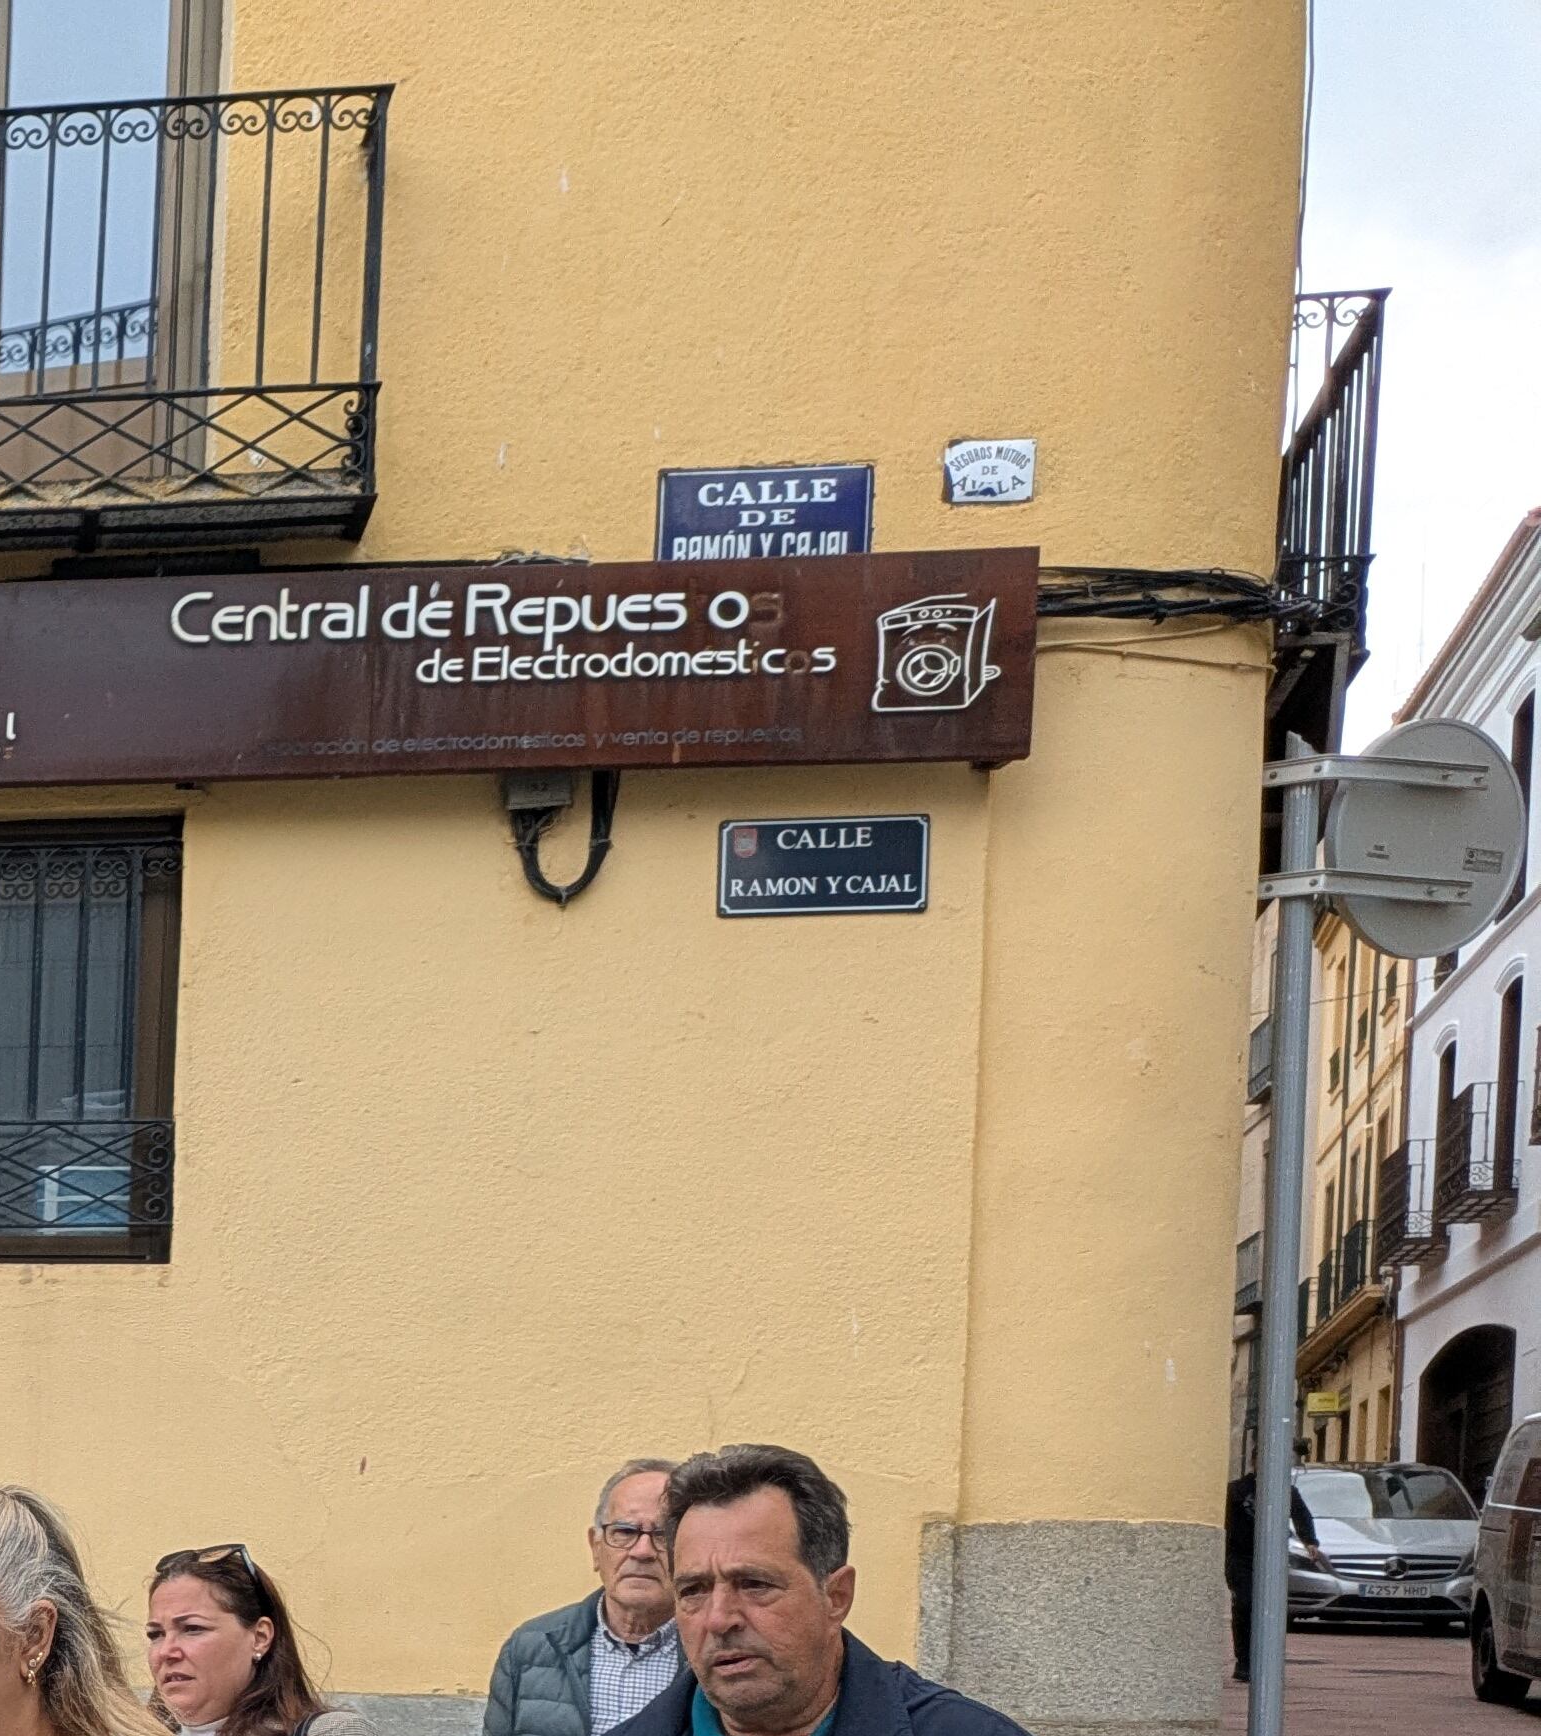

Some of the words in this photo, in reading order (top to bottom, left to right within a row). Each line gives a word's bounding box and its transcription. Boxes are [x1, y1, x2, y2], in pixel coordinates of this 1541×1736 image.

[949, 446, 993, 472] SEGUROS
[995, 446, 1031, 470] MUTUOS
[981, 465, 999, 475] DE
[697, 477, 837, 507] CALLE
[738, 508, 797, 527] DE
[672, 529, 752, 561] RAMÓN
[759, 532, 776, 557] Y
[170, 584, 370, 644] Central
[416, 648, 465, 683] de
[611, 729, 668, 747] venta
[671, 728, 700, 745] de
[777, 826, 873, 850] CALLE
[729, 876, 817, 897] RAMON
[826, 876, 842, 894] Y
[845, 874, 918, 894] CAJAL
